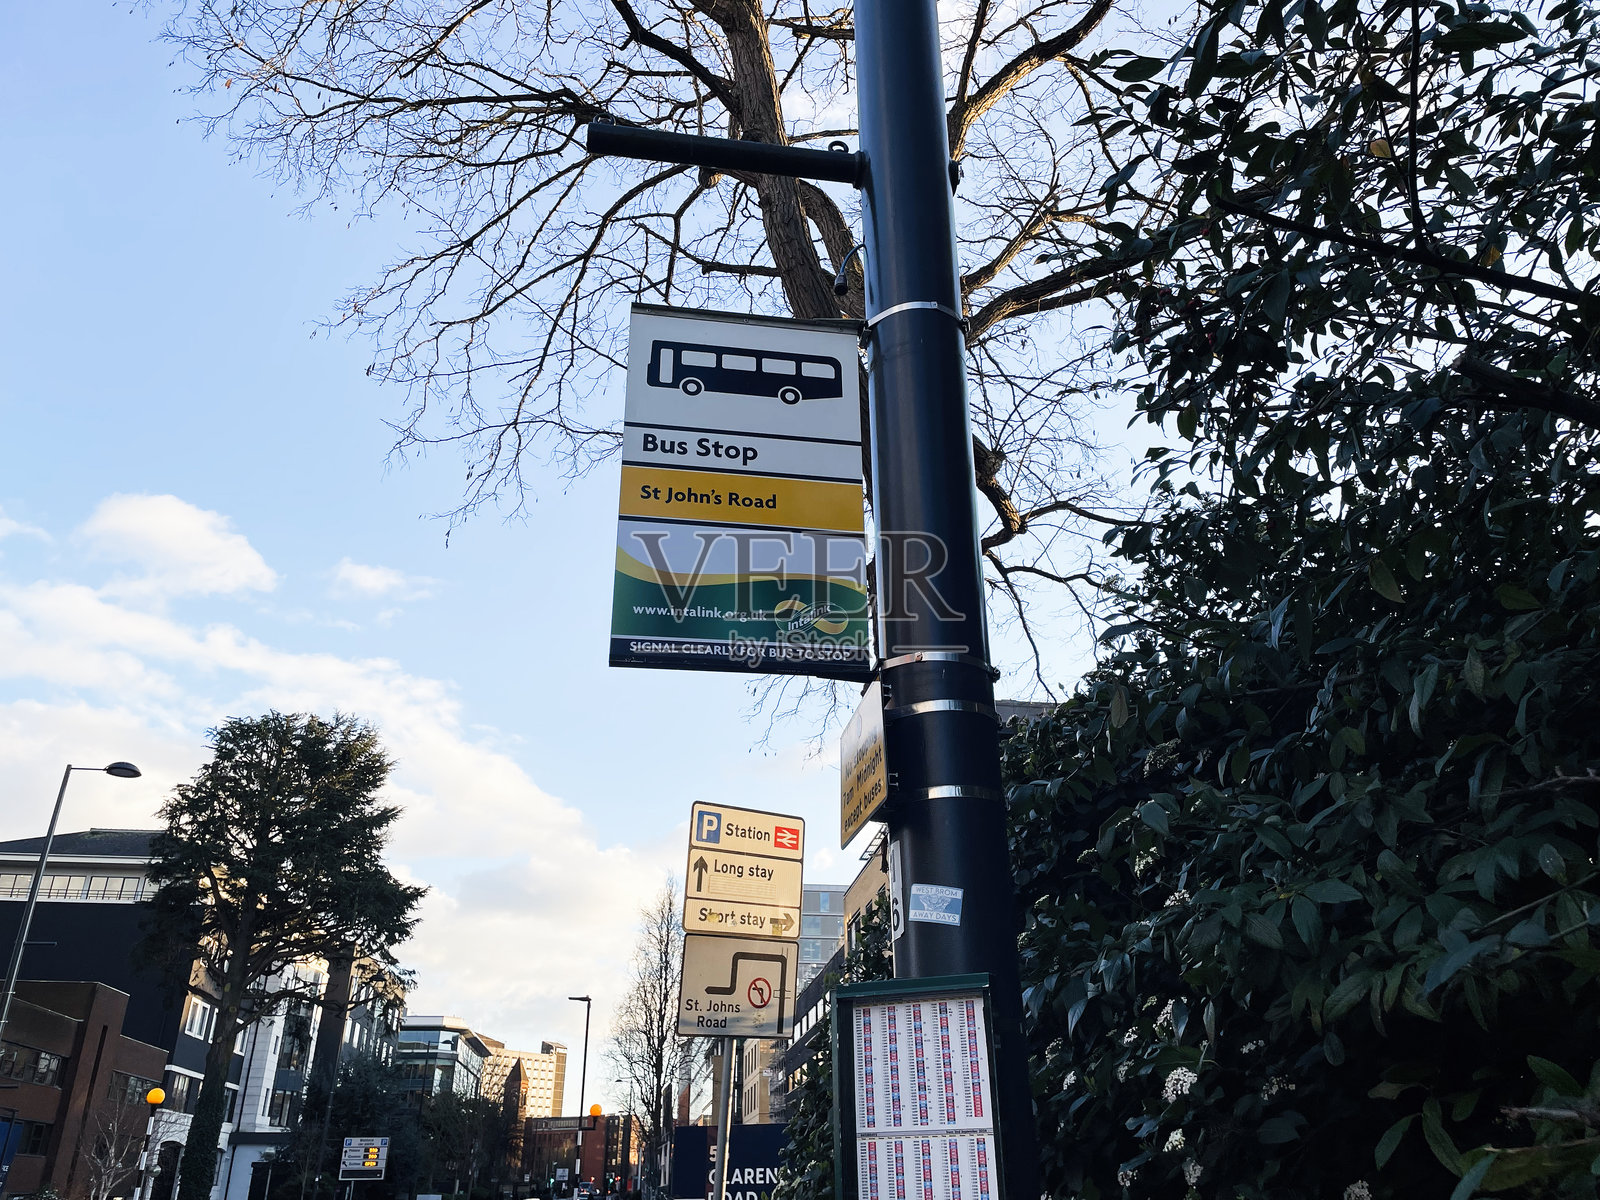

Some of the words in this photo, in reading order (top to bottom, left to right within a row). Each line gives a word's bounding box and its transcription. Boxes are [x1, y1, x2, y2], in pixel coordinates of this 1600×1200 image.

[643, 433, 688, 455] Bus
[696, 438, 758, 466] Stop
[640, 485, 661, 500] St
[665, 487, 722, 505] John's
[728, 492, 777, 509] Road
[633, 605, 767, 622] www.intalink.org.uk
[787, 604, 832, 632] Intalink
[629, 641, 679, 655] SIGNAL
[682, 643, 737, 657] CLEARLY
[740, 647, 766, 658] FOR
[769, 648, 794, 660] BUS
[797, 650, 813, 661] TO
[817, 651, 851, 662] STOP
[856, 745, 882, 791] Midnight
[844, 799, 863, 832] except
[863, 778, 882, 810] buses
[725, 822, 770, 841] Station
[714, 859, 744, 877] Long
[748, 864, 774, 881] stay
[916, 886, 934, 894] WEST
[935, 888, 958, 897] BROM
[740, 912, 766, 928] stay
[913, 911, 934, 919] AWAY
[936, 912, 957, 922] DAYS
[685, 998, 702, 1012] St.
[706, 999, 741, 1013] Johns
[696, 1015, 727, 1029] Road
